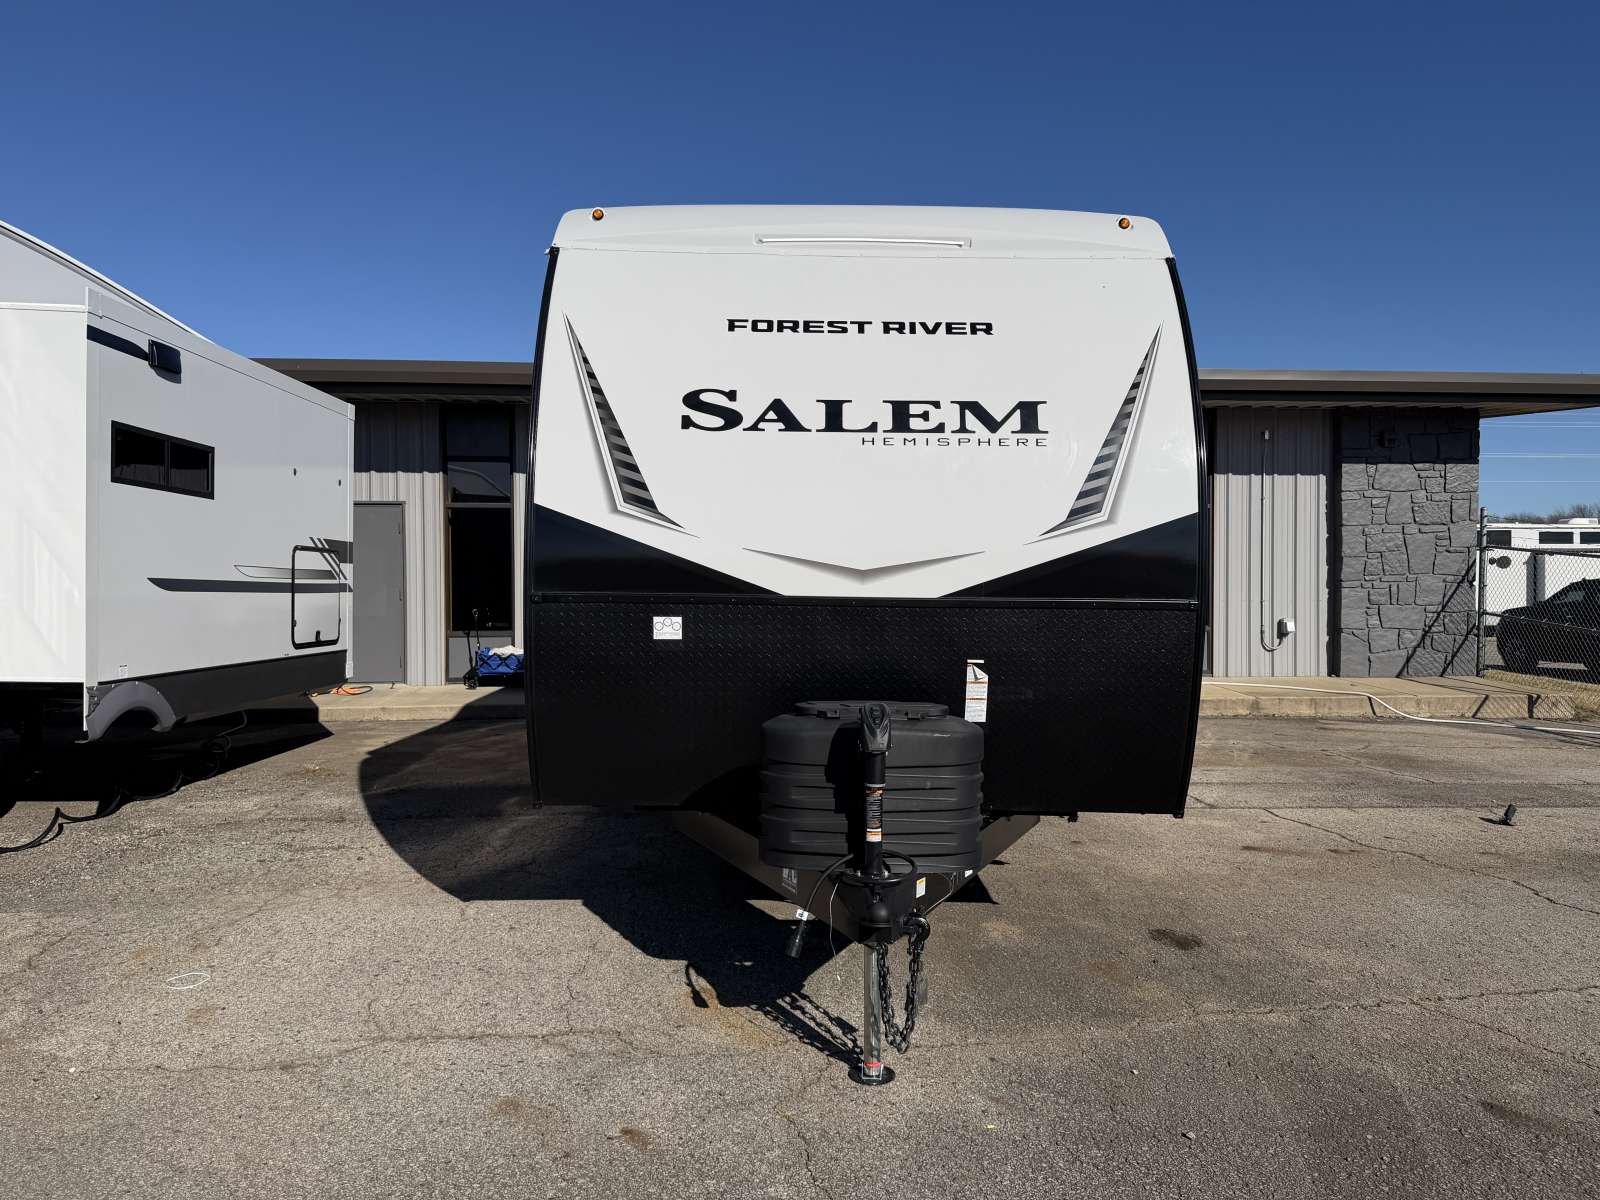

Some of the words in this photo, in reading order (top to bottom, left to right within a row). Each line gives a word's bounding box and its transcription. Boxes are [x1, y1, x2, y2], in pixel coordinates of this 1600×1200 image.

[727, 318, 872, 335] FOREST
[881, 320, 994, 336] RIVER
[680, 388, 1049, 434] SALEM
[861, 436, 1048, 447] HEMISPHERE
